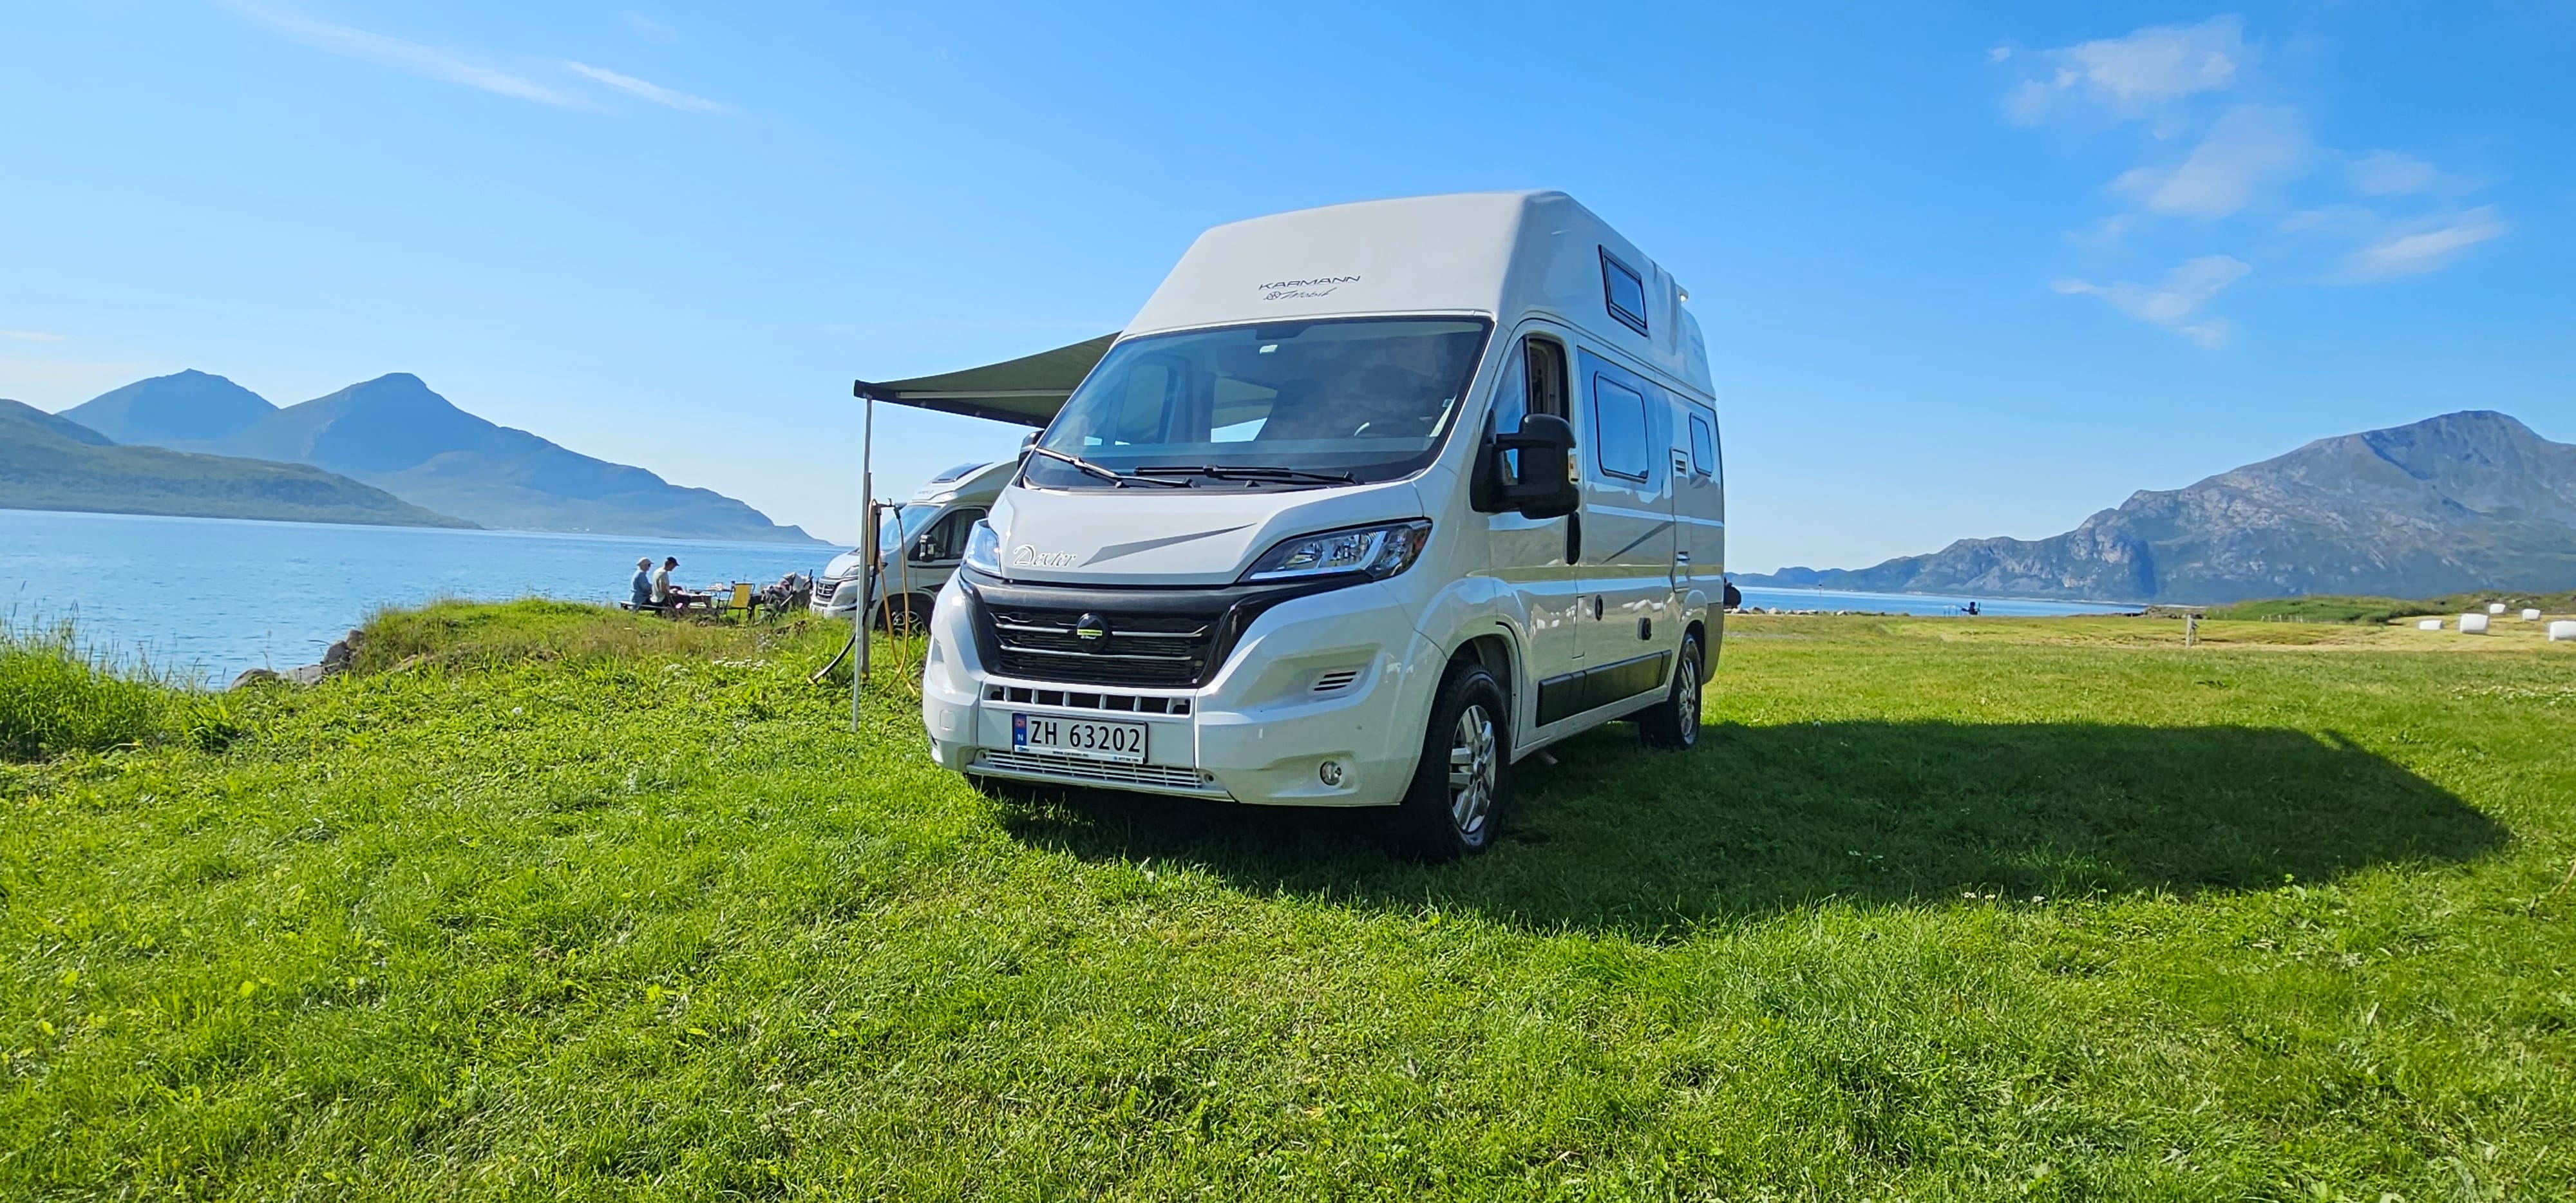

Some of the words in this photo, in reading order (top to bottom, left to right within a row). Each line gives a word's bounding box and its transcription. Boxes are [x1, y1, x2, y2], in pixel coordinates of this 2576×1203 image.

[1258, 276, 1361, 290] KARMANN
[1030, 720, 1057, 746] ZH
[1069, 723, 1141, 753] 63202
